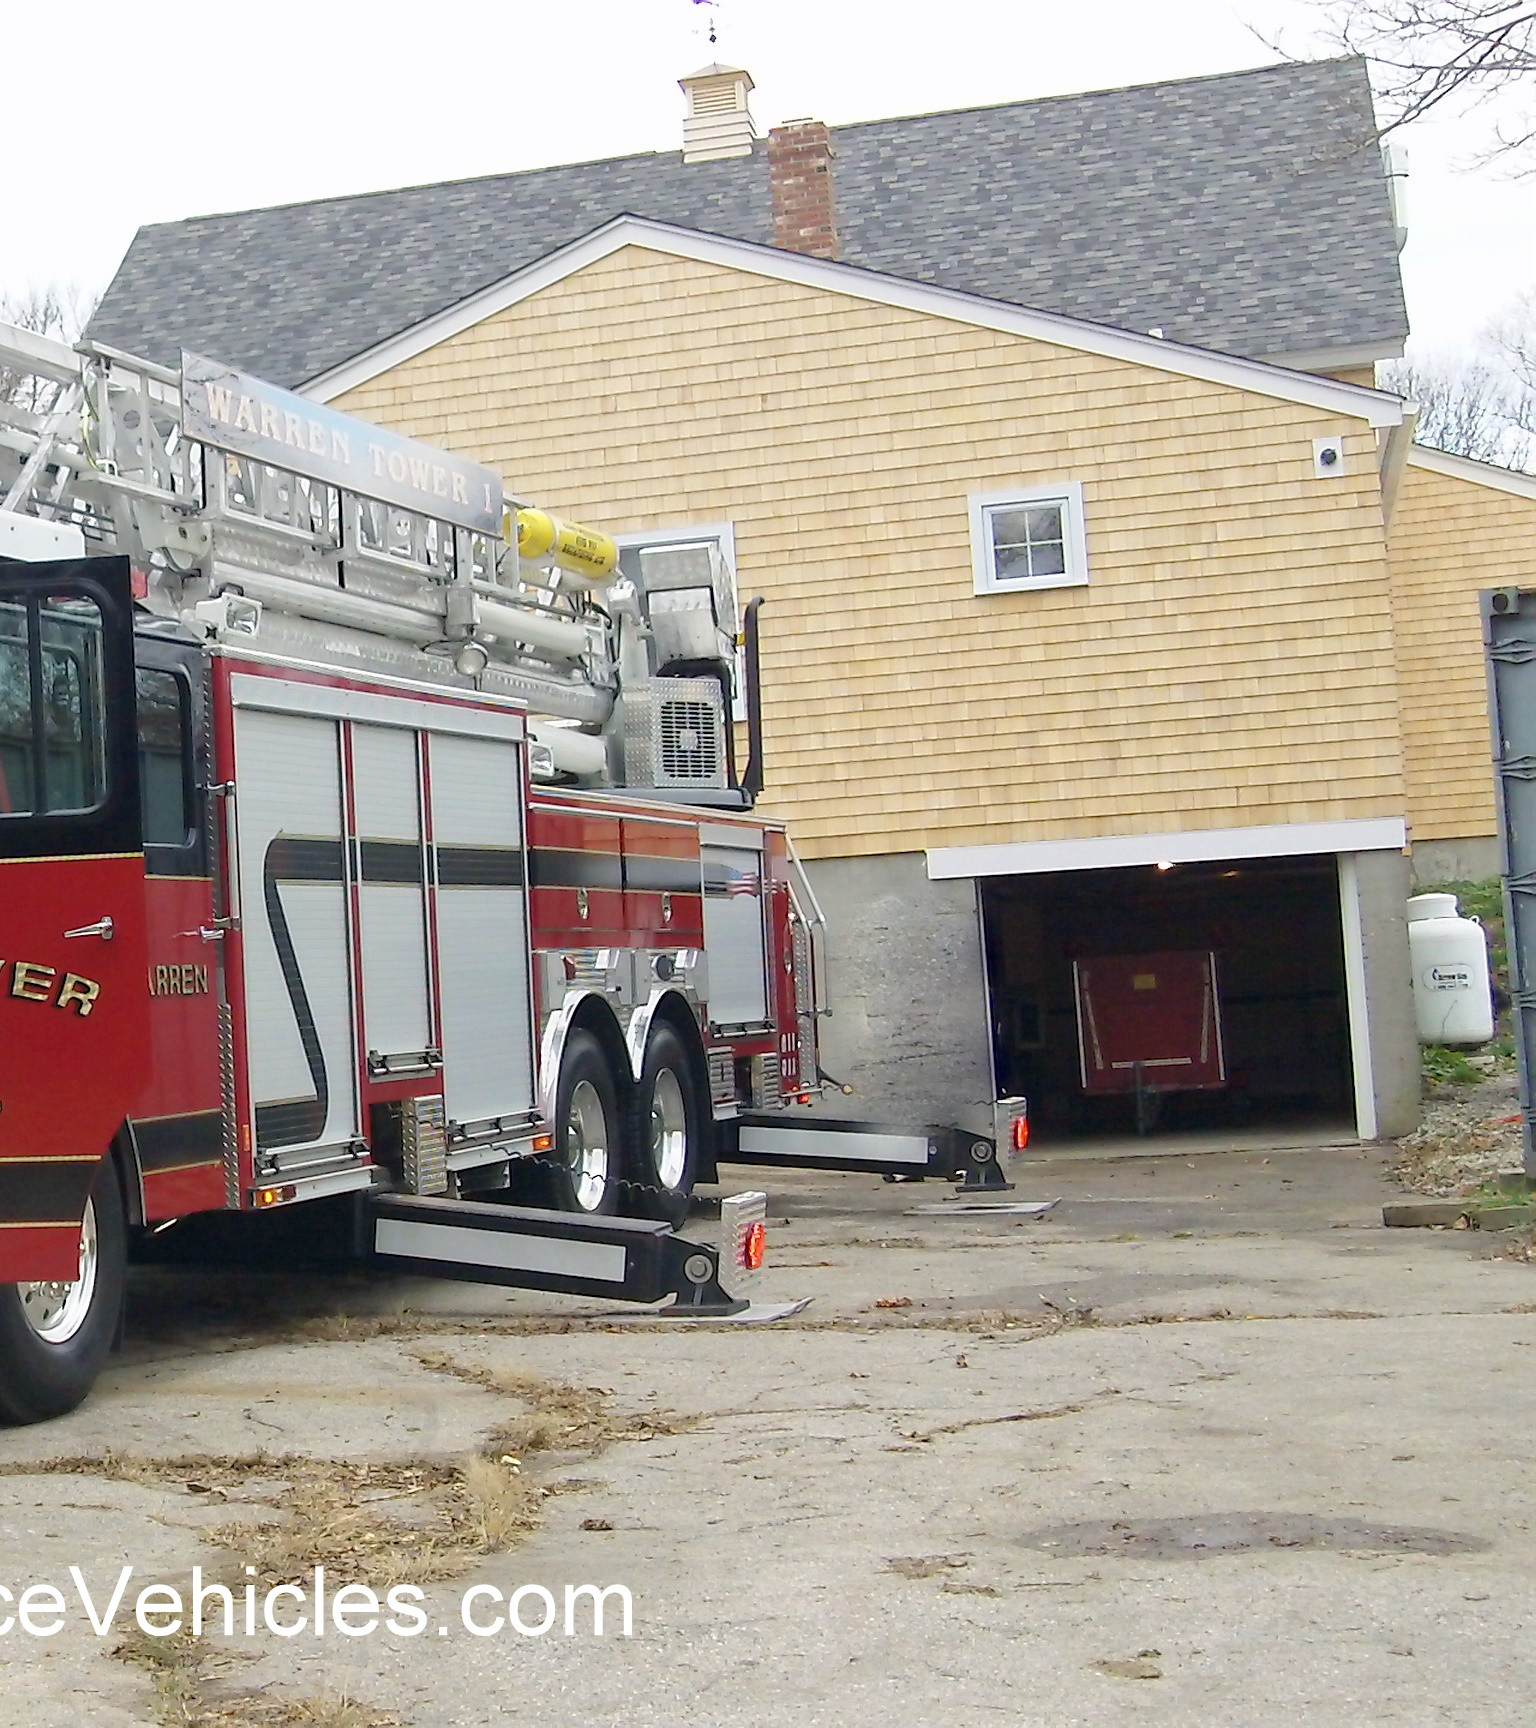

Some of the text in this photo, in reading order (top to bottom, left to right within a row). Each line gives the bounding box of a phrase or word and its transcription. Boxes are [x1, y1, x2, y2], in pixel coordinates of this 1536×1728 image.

[204, 382, 493, 514] WARREN TOWER 1
